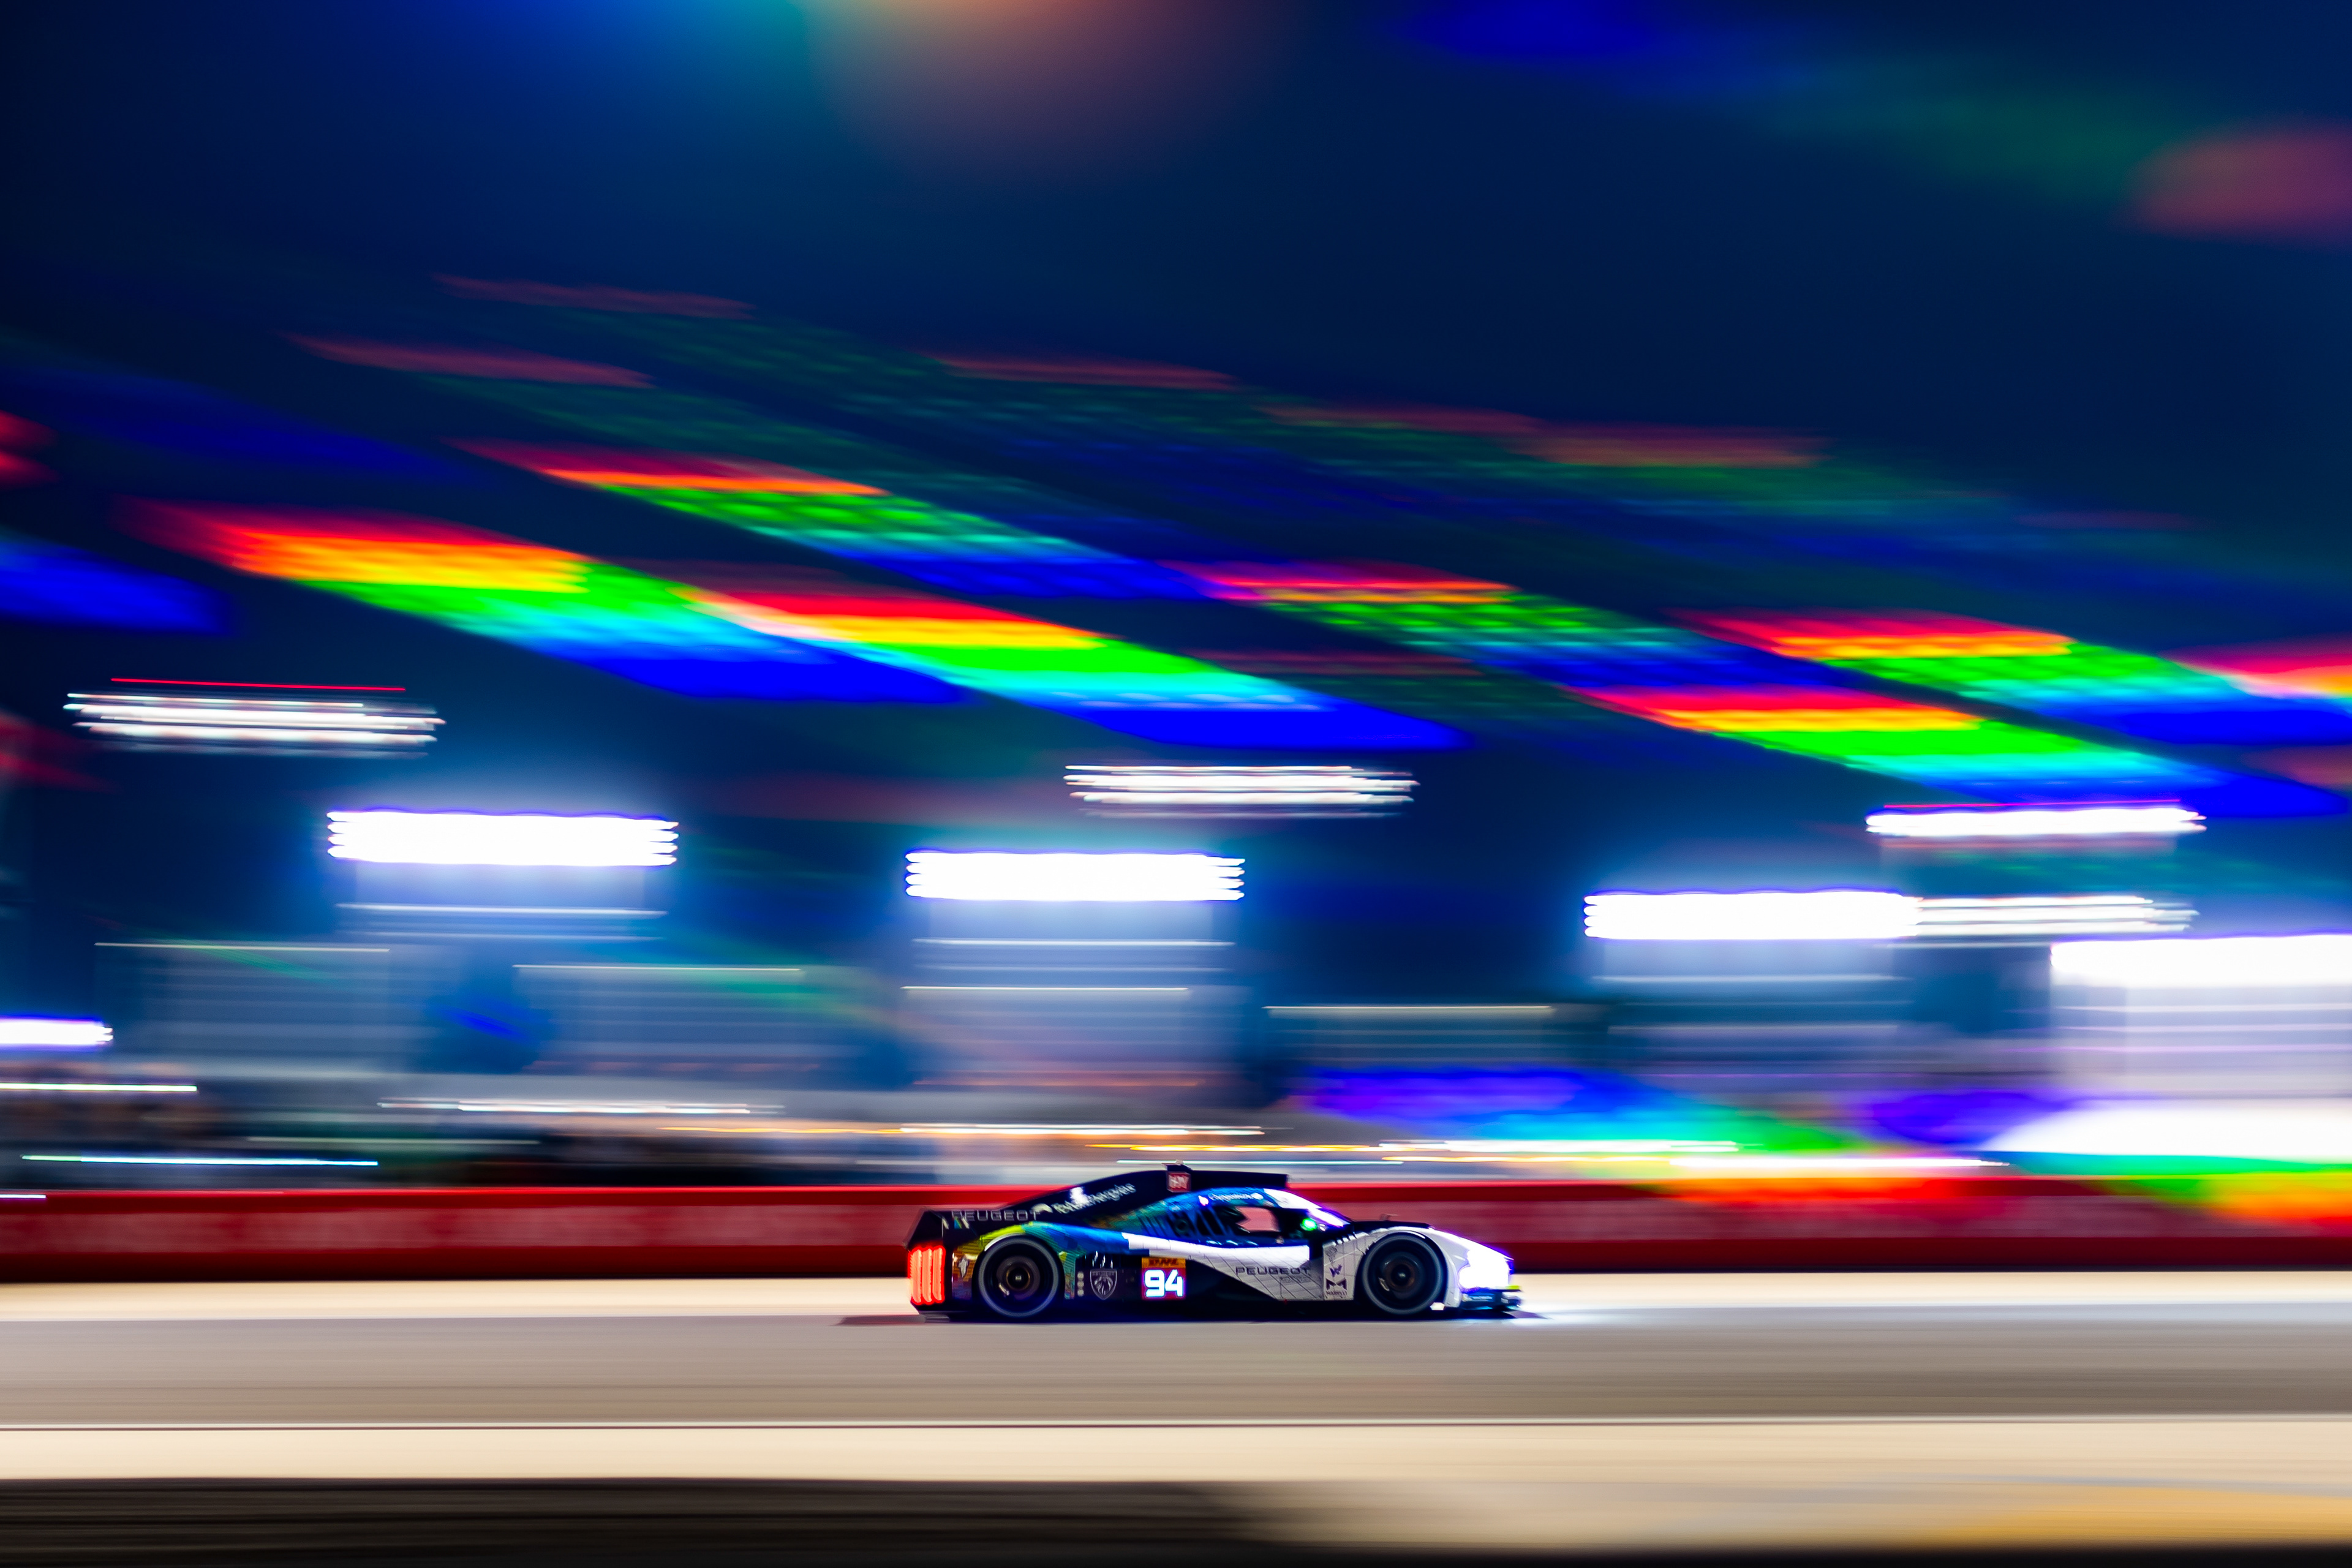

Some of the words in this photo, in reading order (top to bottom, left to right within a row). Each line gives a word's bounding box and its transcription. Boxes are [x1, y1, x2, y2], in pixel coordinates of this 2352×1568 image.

[951, 1210, 1041, 1221] PEUGEOT
[1235, 1266, 1310, 1275] PEUGEOT
[1144, 1269, 1183, 1297] 94
